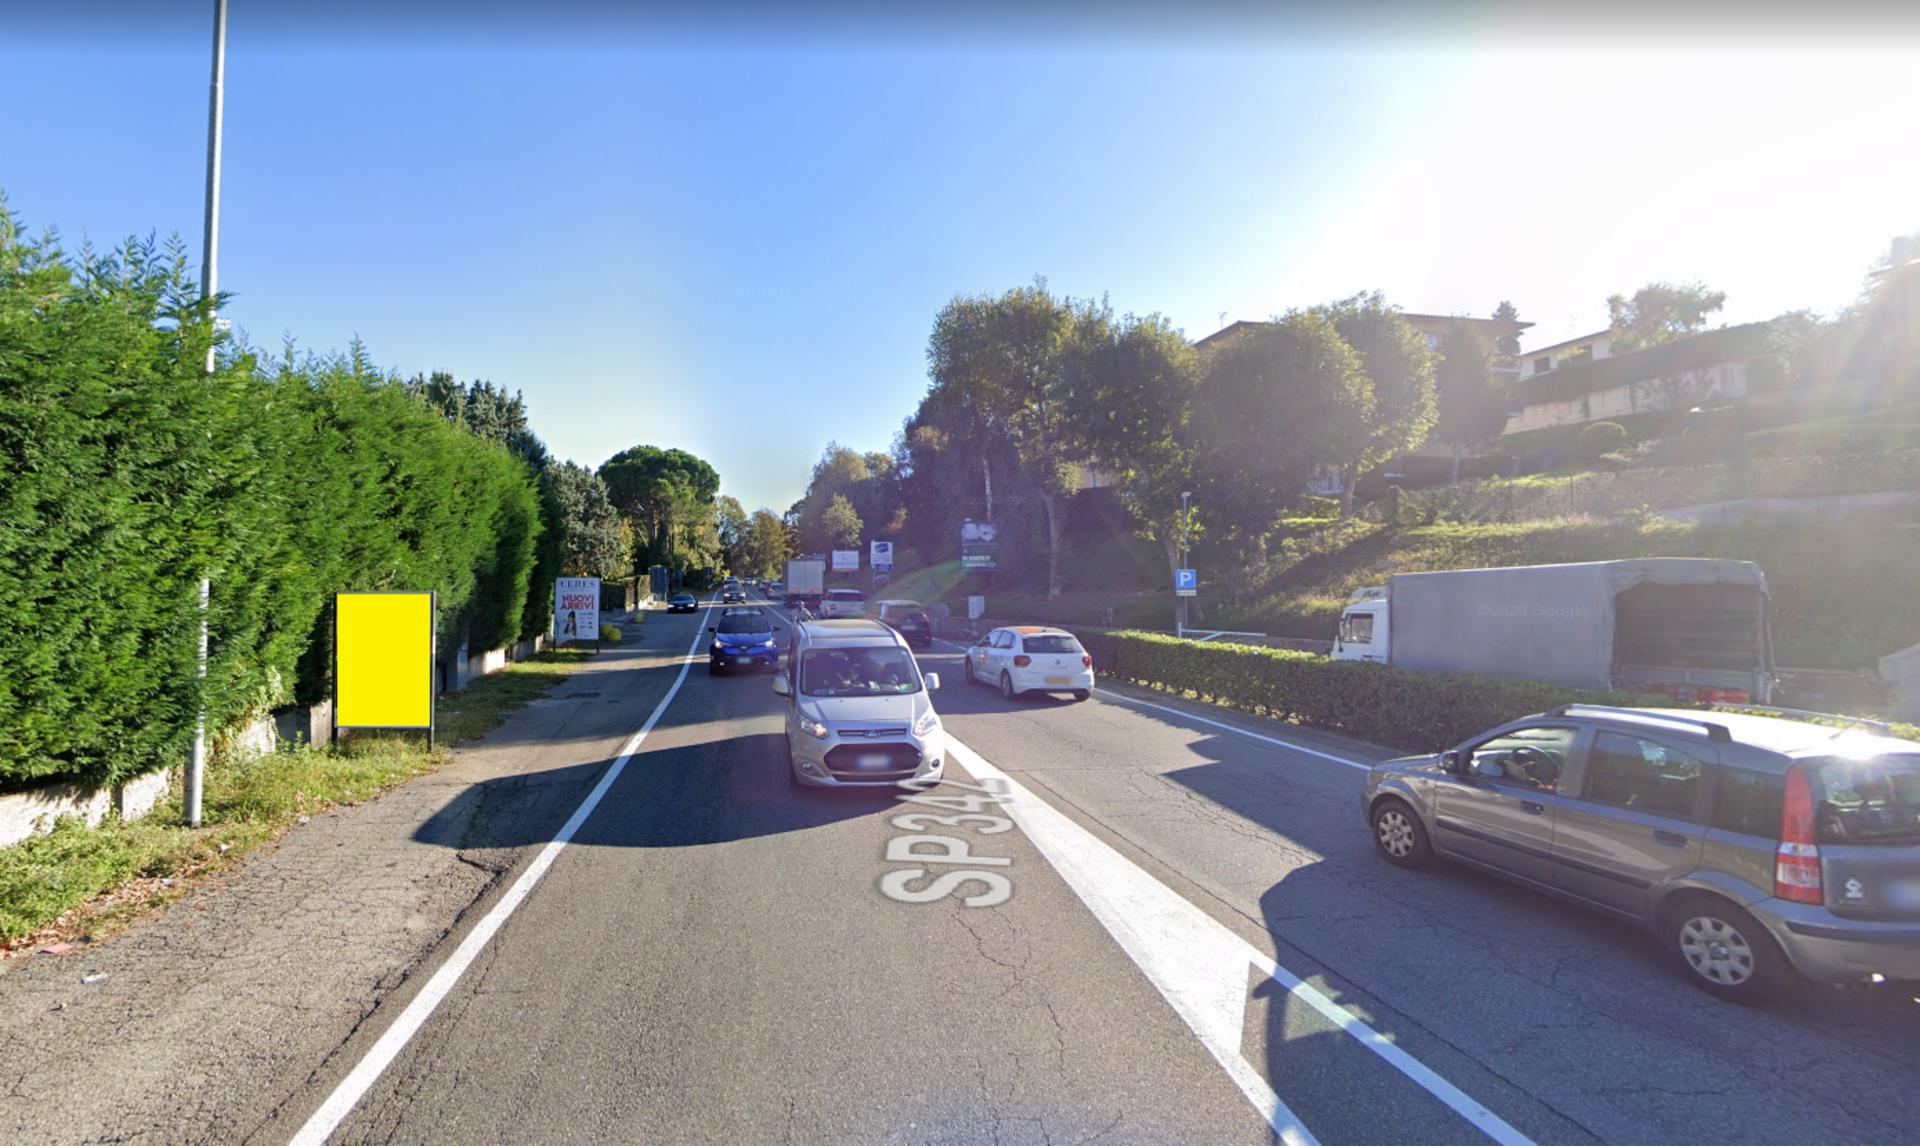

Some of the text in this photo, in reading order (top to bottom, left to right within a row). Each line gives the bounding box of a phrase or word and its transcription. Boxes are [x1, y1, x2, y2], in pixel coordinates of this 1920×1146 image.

[1180, 572, 1192, 586] P
[562, 594, 594, 602] NUOVI
[560, 602, 594, 610] ARRIVI
